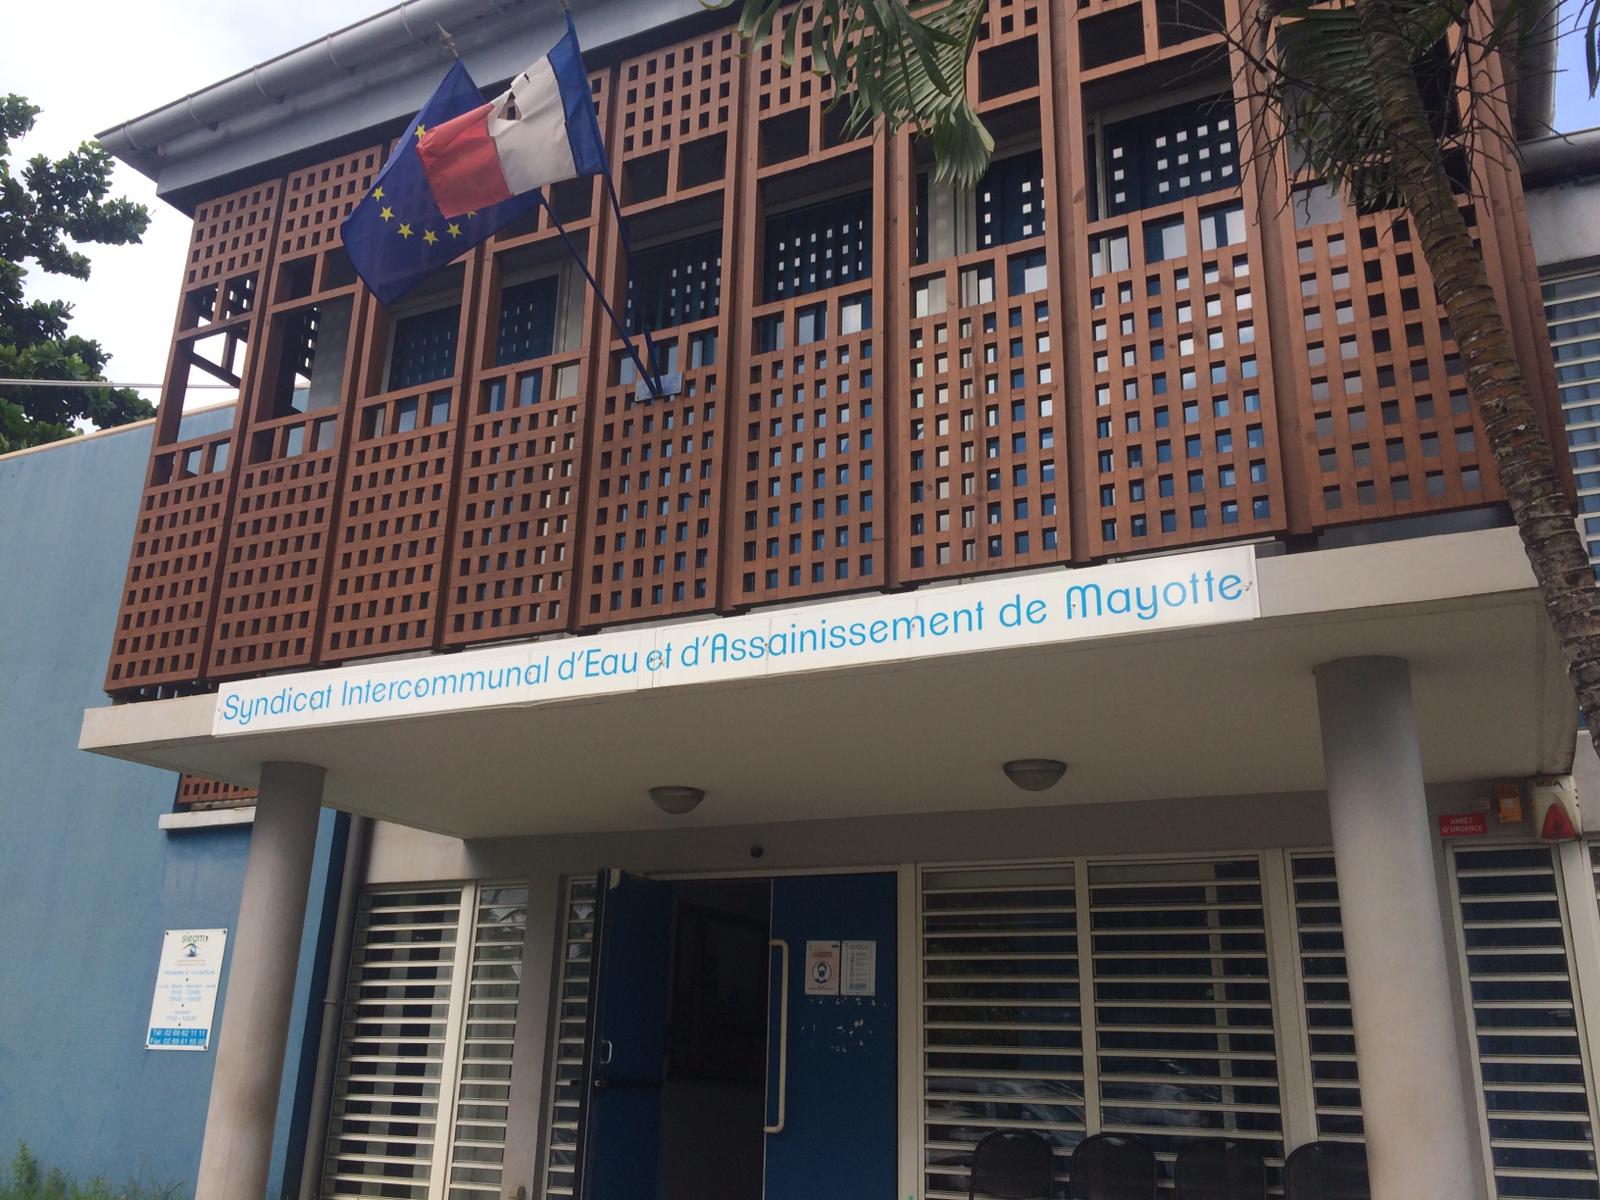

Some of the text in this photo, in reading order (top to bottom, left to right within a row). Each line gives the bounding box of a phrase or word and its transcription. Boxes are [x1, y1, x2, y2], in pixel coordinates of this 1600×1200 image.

[223, 570, 1243, 725] Syndicat Intercommunal d'Eau et d'Assainissement de Mayotte
